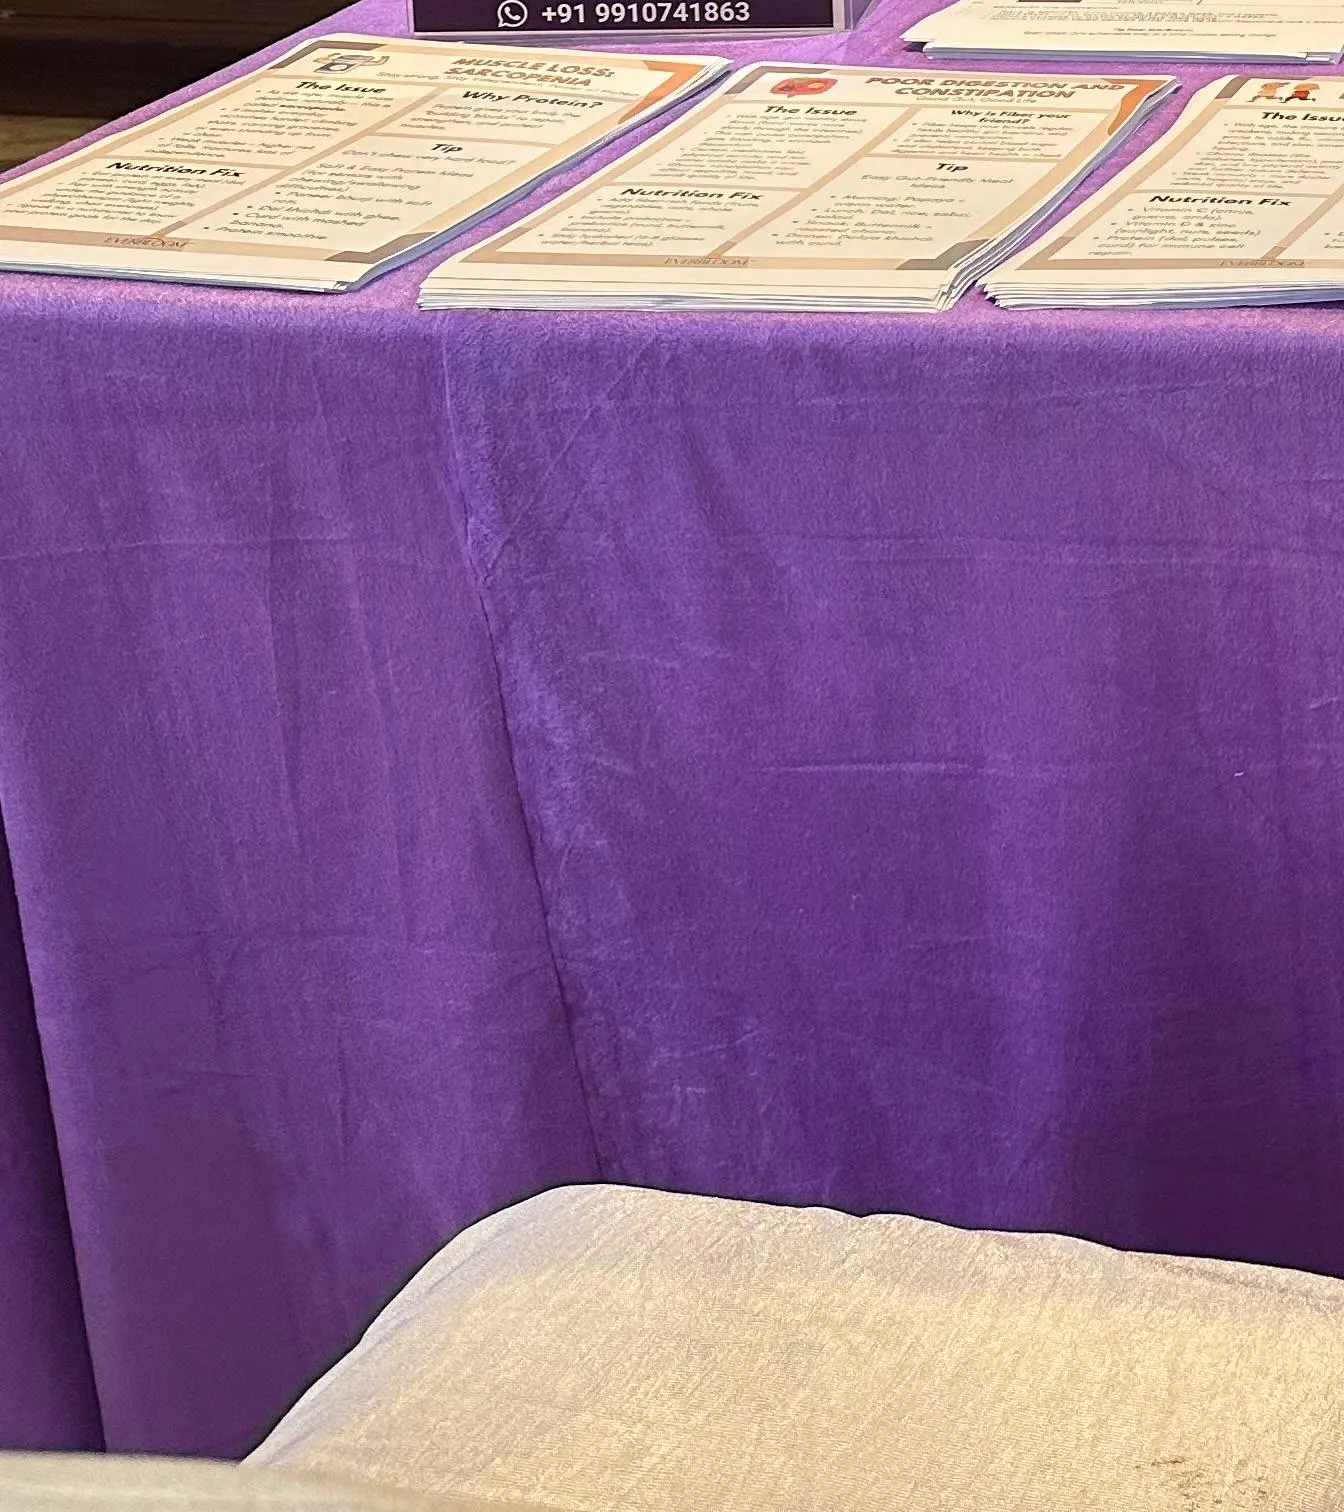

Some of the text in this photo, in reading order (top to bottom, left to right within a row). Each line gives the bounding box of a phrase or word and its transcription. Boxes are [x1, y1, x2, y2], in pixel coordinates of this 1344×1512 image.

[542, 2, 749, 23] +91 9910741863
[453, 58, 615, 77] MUSCLE LOSS:
[443, 67, 592, 87] SARCOPENIA
[295, 81, 386, 93] The Issue
[866, 78, 1125, 91] POOR DIGESTION AND
[895, 87, 1076, 98] CONSTIPATION
[461, 91, 602, 109] Why Protein?
[764, 106, 857, 115] The Issue
[1260, 112, 1299, 120] The
[432, 144, 462, 153] Tip
[106, 161, 245, 177] Nutrition Fix
[936, 163, 968, 172] Tip
[620, 188, 764, 200] Nutrition Fix
[1149, 195, 1292, 206] Nutrition Fix
